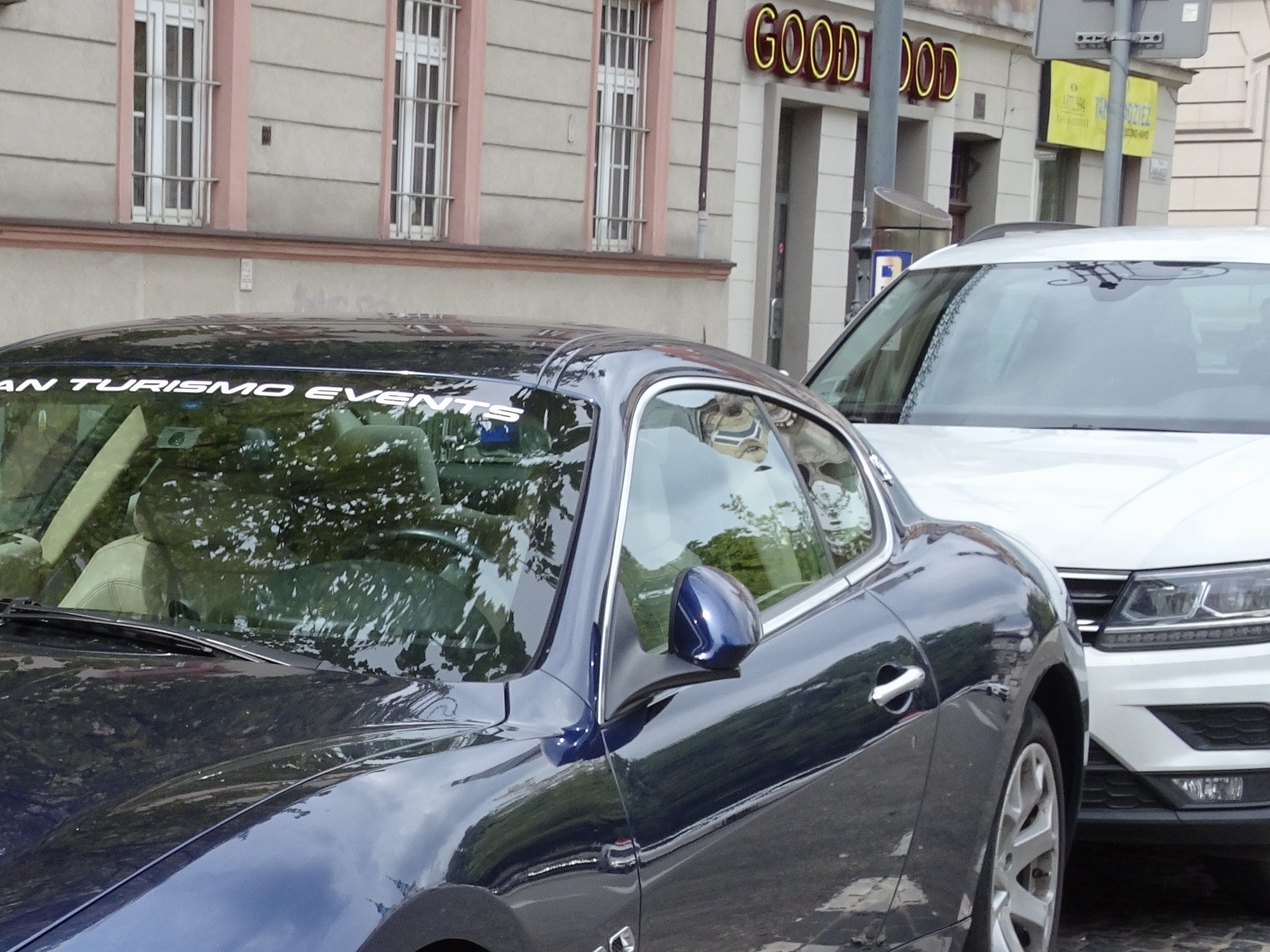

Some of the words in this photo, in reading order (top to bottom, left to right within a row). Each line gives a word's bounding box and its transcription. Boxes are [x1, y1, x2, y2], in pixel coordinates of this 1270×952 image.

[747, 4, 859, 82] GOOD
[69, 378, 295, 396] TURISMO
[304, 385, 524, 423] EVENTS
